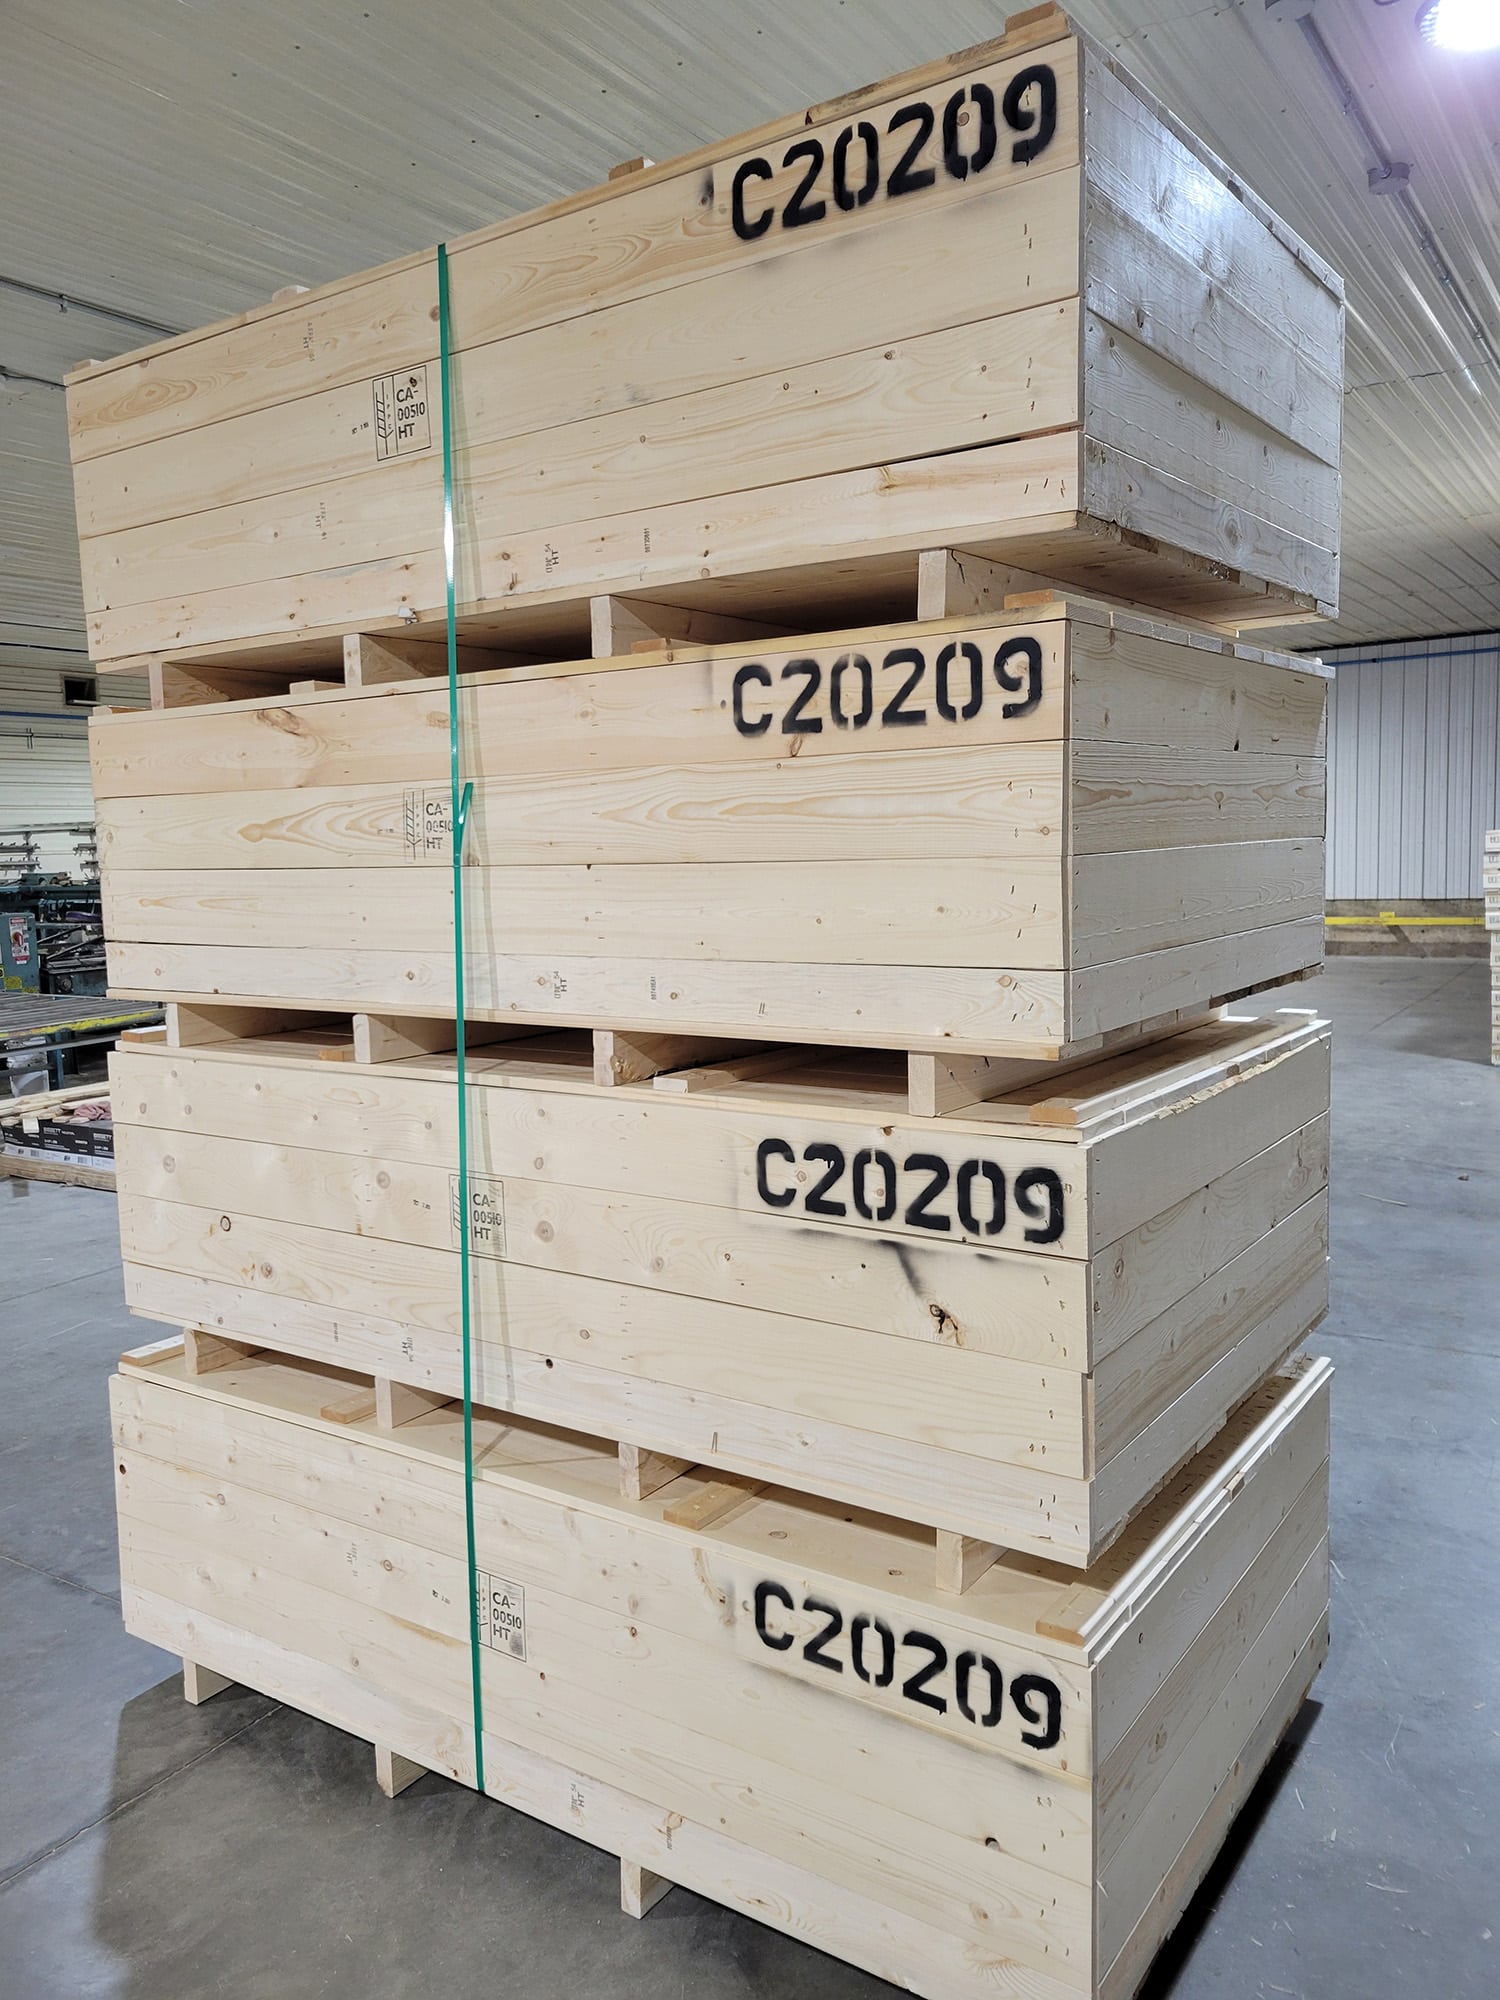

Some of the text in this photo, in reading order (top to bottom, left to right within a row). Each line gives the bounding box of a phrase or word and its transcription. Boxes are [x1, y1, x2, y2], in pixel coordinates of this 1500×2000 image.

[732, 64, 1057, 240] C20209
[396, 387, 419, 403] CA-
[397, 401, 426, 421] 00510
[398, 422, 416, 440] HT
[551, 550, 559, 566] HT
[733, 636, 1042, 737] C20209
[425, 803, 449, 816] CA-
[426, 837, 443, 850] HT
[560, 978, 568, 993] HT
[756, 1137, 1065, 1244] C20209
[472, 1193, 496, 1208] CA-
[473, 1209, 503, 1226] 00510
[474, 1226, 491, 1240] HT
[492, 1591, 517, 1610] CA-
[492, 1607, 523, 1630] 00510
[493, 1623, 511, 1641] HT
[754, 1580, 1062, 1750] C20209
[577, 1791, 585, 1808] HT
